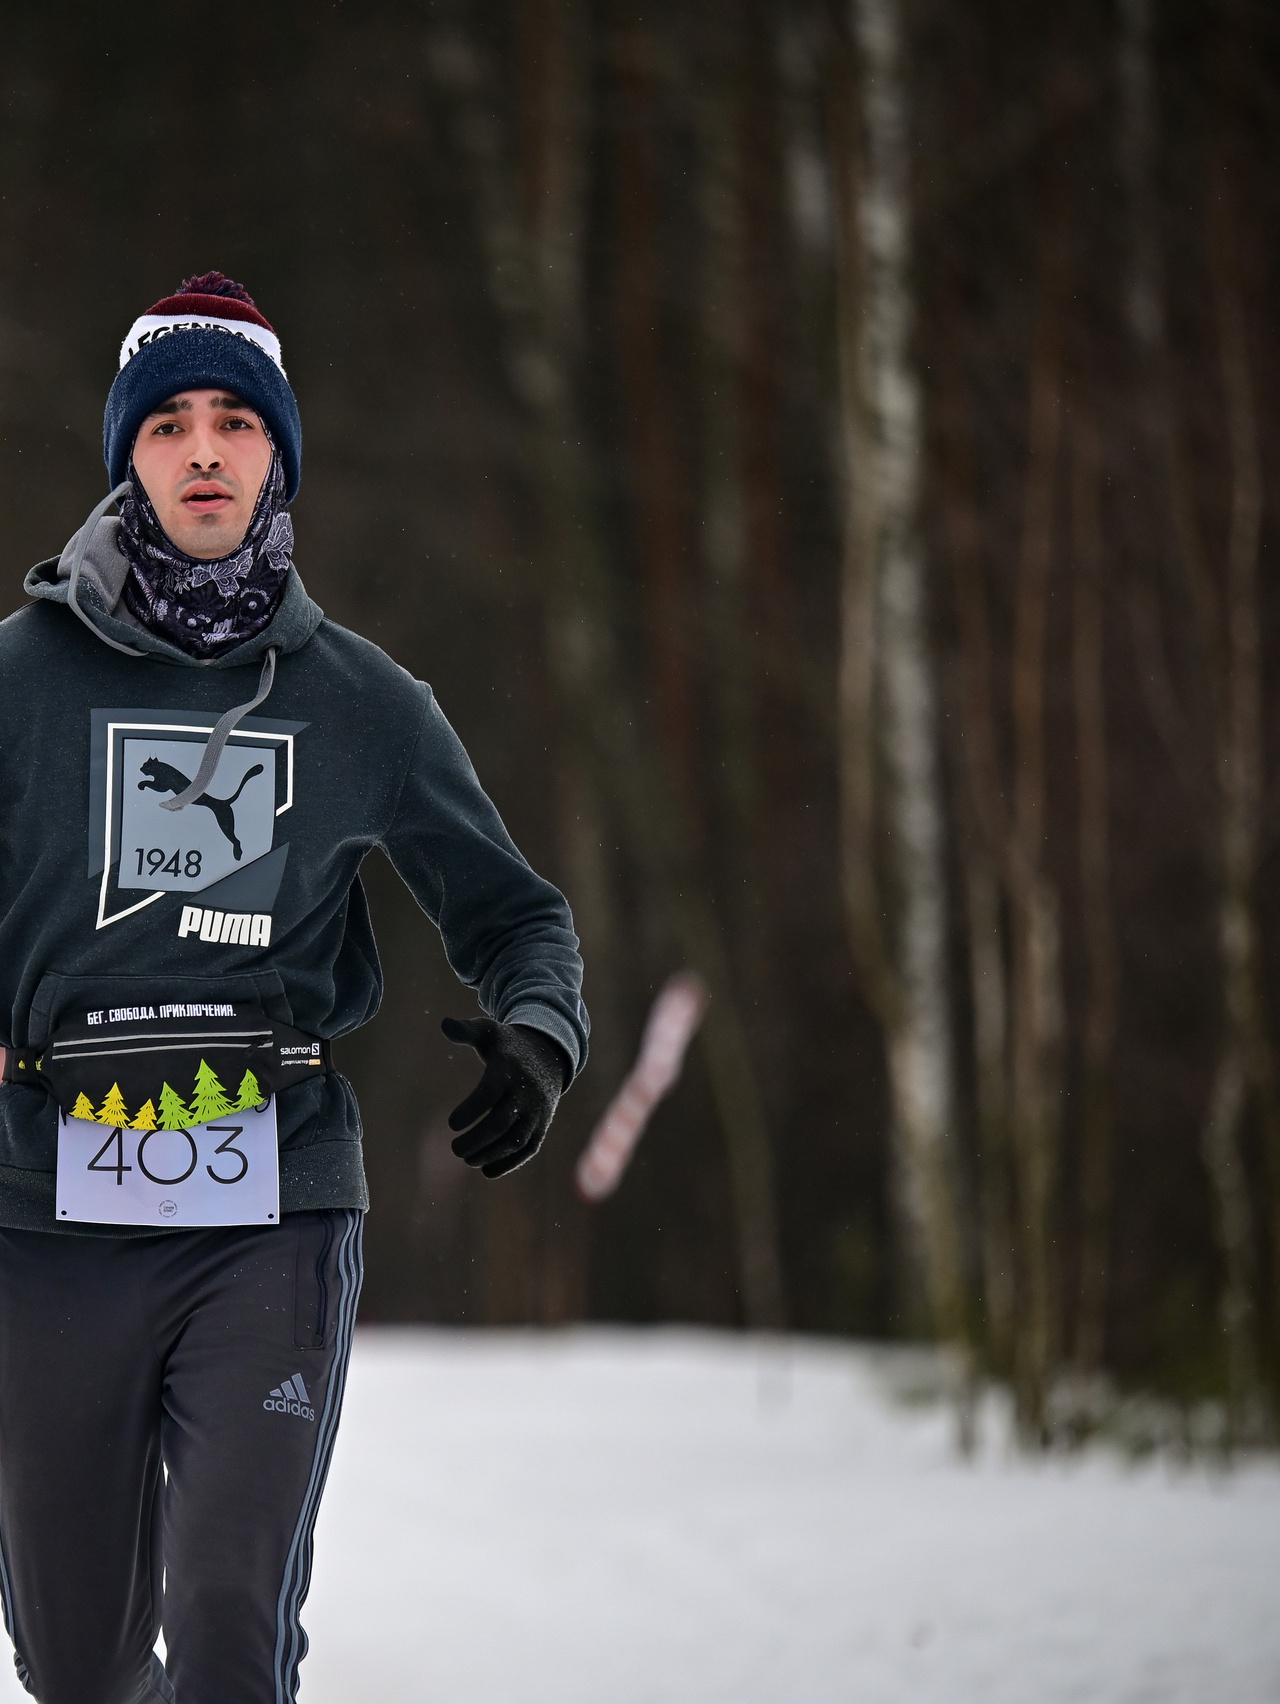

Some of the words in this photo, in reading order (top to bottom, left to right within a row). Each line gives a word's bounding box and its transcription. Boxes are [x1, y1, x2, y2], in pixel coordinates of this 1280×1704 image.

[135, 847, 202, 878] 1948
[177, 905, 272, 947] PUMA
[87, 1010, 108, 1025] БЕГ.
[109, 1006, 158, 1022] СВОБОДА.
[159, 1004, 237, 1018] ПРИКЛЮЧЕНИЯ.
[87, 1126, 249, 1185] 403
[262, 1397, 315, 1421] adidas
